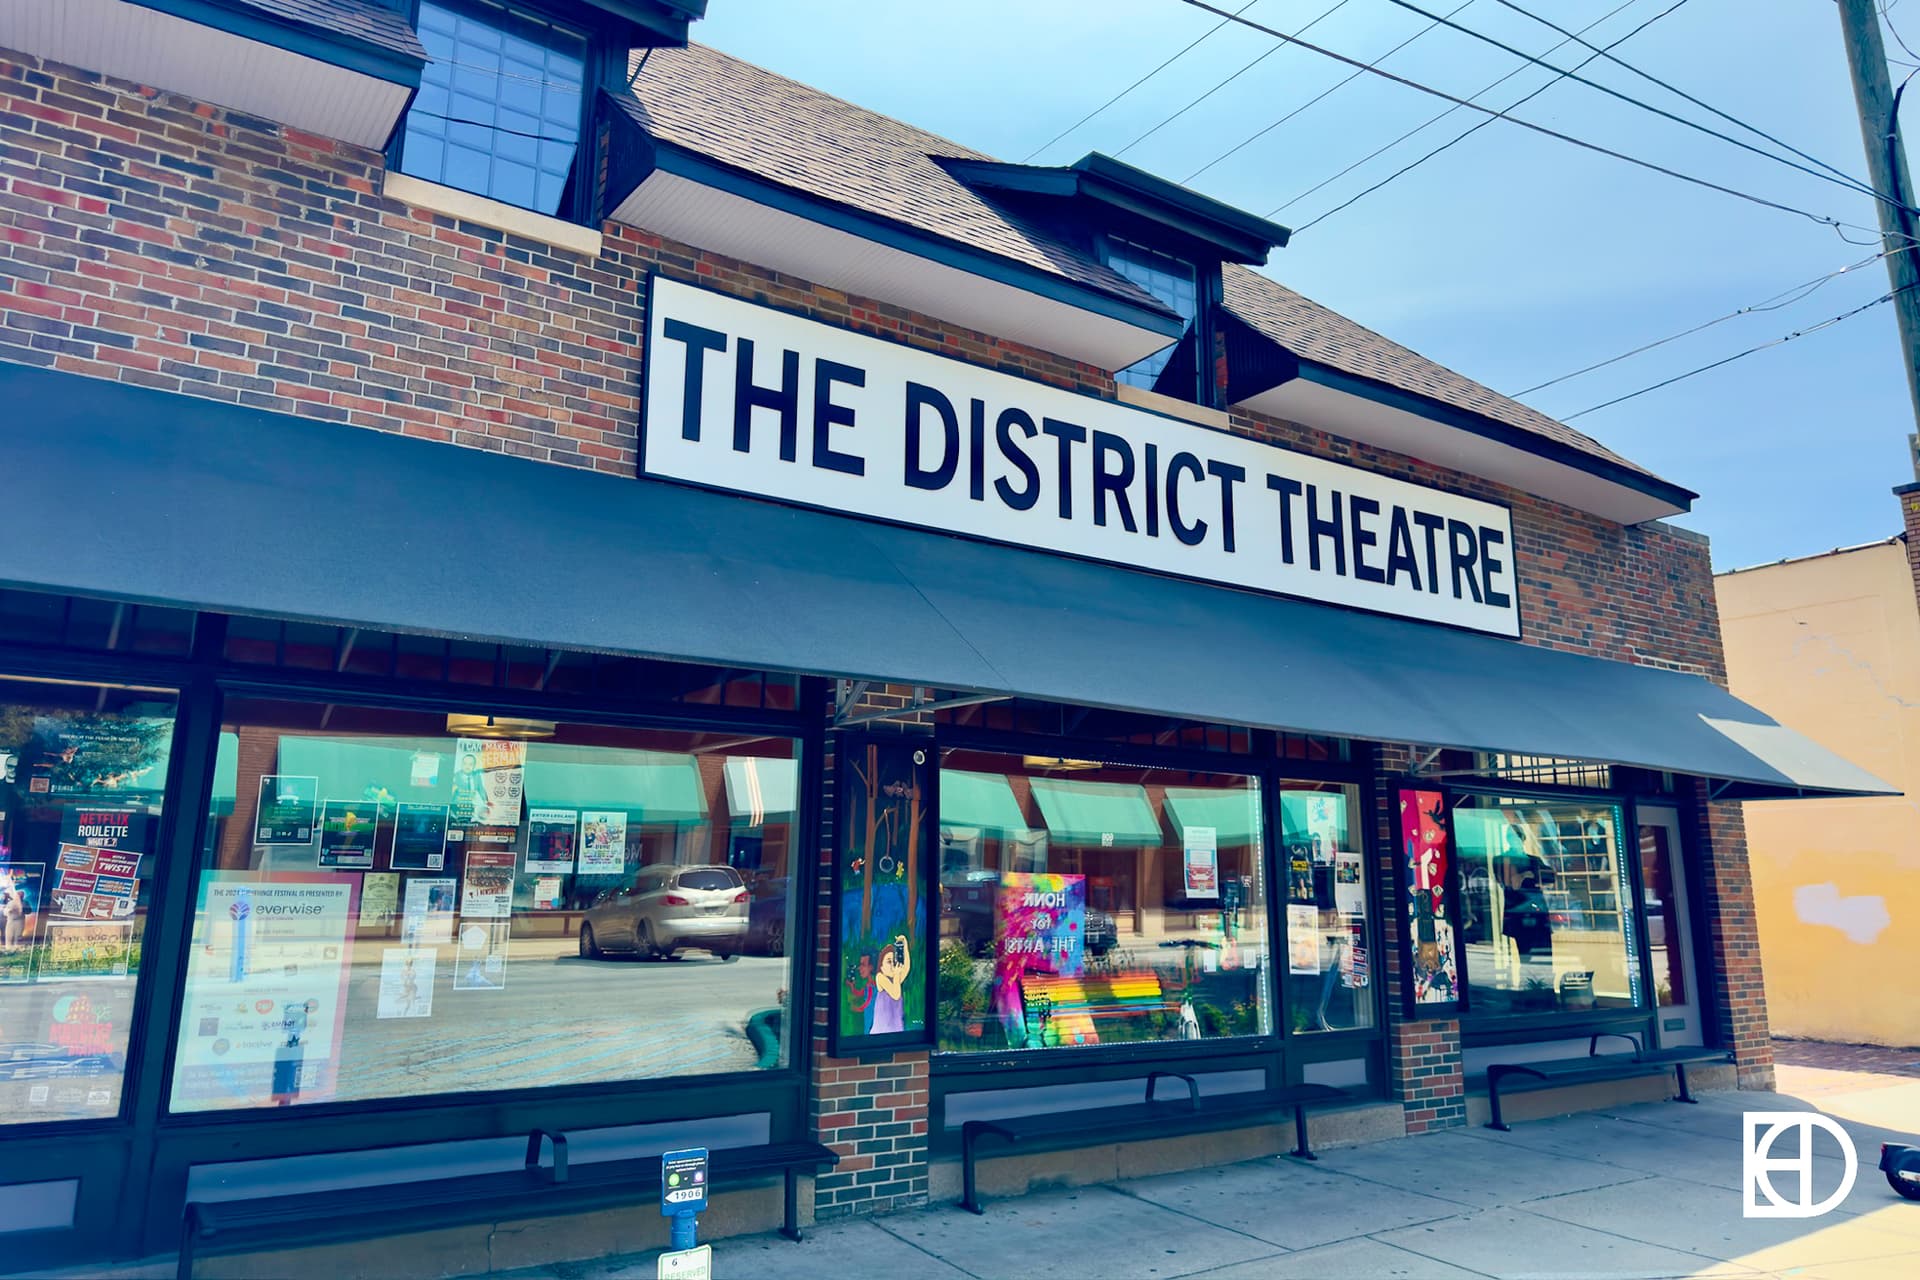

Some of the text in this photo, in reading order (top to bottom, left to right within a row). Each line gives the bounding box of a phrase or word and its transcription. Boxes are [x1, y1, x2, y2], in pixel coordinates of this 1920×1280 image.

[664, 318, 1511, 609] THE DISTRICT THEATRE
[485, 743, 508, 752] MAKE
[79, 813, 129, 826] NETFLIX
[77, 825, 129, 838] ROULETTE
[97, 862, 132, 874] TWIST!
[273, 889, 298, 897] FESTIVAL
[675, 1190, 701, 1200] 1906
[672, 1258, 678, 1266] 6
